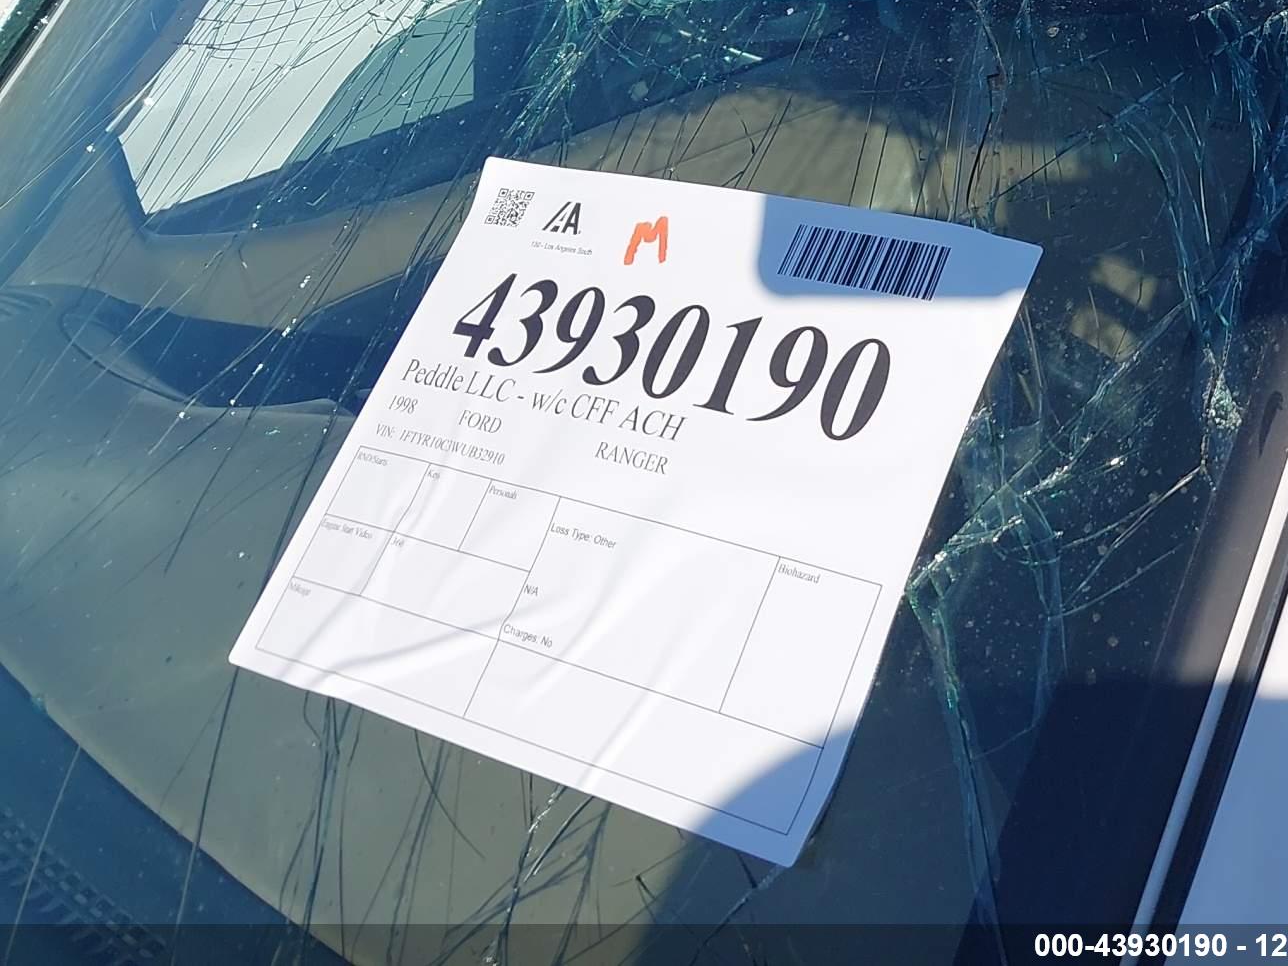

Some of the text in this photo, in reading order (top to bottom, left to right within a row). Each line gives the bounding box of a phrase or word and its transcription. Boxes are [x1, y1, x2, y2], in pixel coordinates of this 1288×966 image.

[624, 216, 668, 265] M
[452, 273, 891, 441] 43930190
[388, 394, 503, 434] 1998 FORD
[402, 359, 464, 392] Peddle
[464, 370, 517, 403] LLC
[531, 388, 568, 416] w/c
[570, 393, 620, 424] CFF
[619, 405, 687, 442] ACH
[376, 423, 395, 439] VIN:
[594, 441, 668, 475] RANGER
[550, 522, 570, 536] Loss
[593, 534, 616, 549] Other
[777, 563, 821, 584] Biohazard
[523, 583, 539, 597] N/A
[540, 635, 553, 648] No
